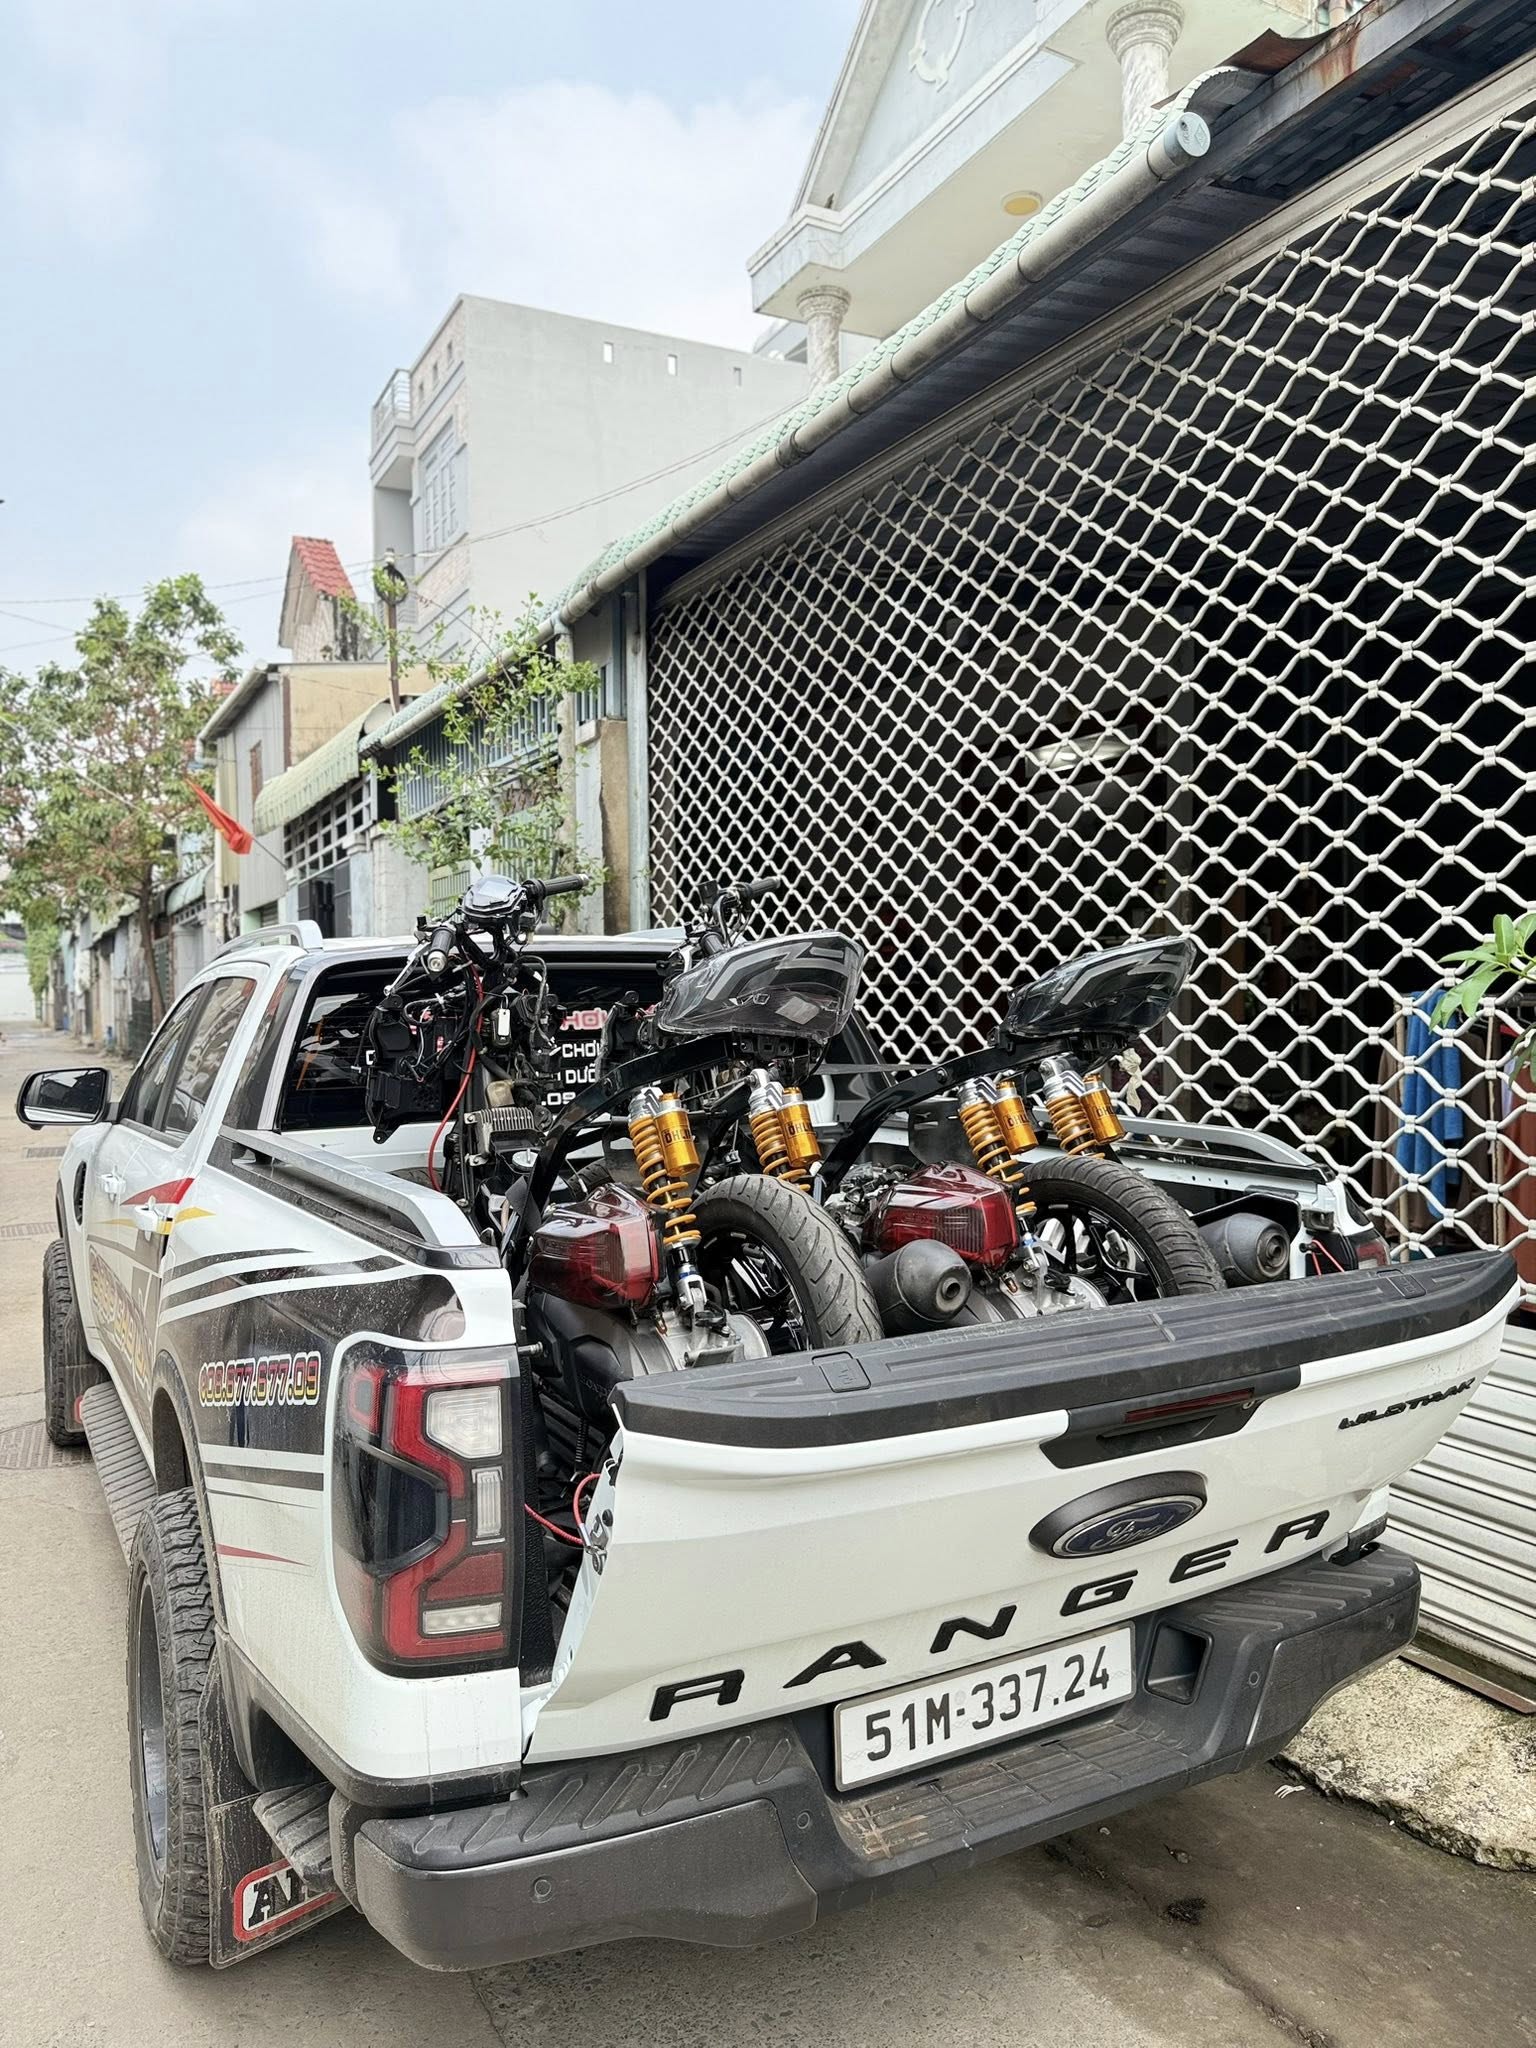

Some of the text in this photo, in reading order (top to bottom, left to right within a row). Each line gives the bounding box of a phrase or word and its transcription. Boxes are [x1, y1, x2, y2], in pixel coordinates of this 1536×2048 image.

[1338, 1376, 1476, 1430] WILDTRAK
[1089, 1512, 1175, 1551] Ford
[649, 1509, 1330, 1722] RANGER
[865, 1645, 1109, 1762] 51M-337.24
